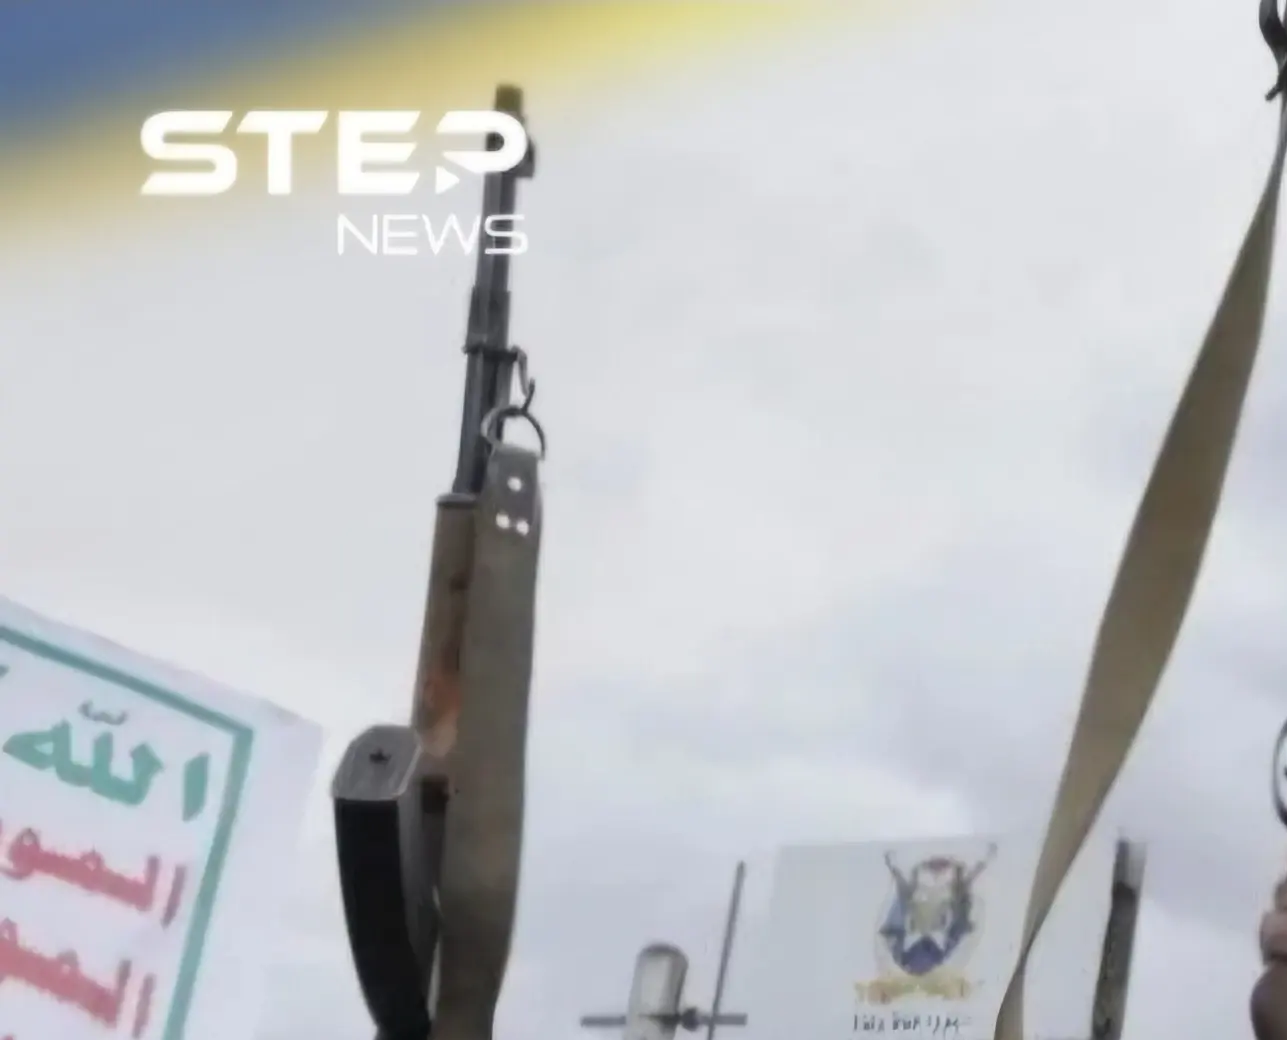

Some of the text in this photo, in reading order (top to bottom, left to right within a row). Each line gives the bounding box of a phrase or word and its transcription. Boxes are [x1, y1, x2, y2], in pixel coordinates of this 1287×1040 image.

[3, 700, 212, 823] الله
[0, 827, 187, 930] المو
[0, 917, 157, 1040] المو
